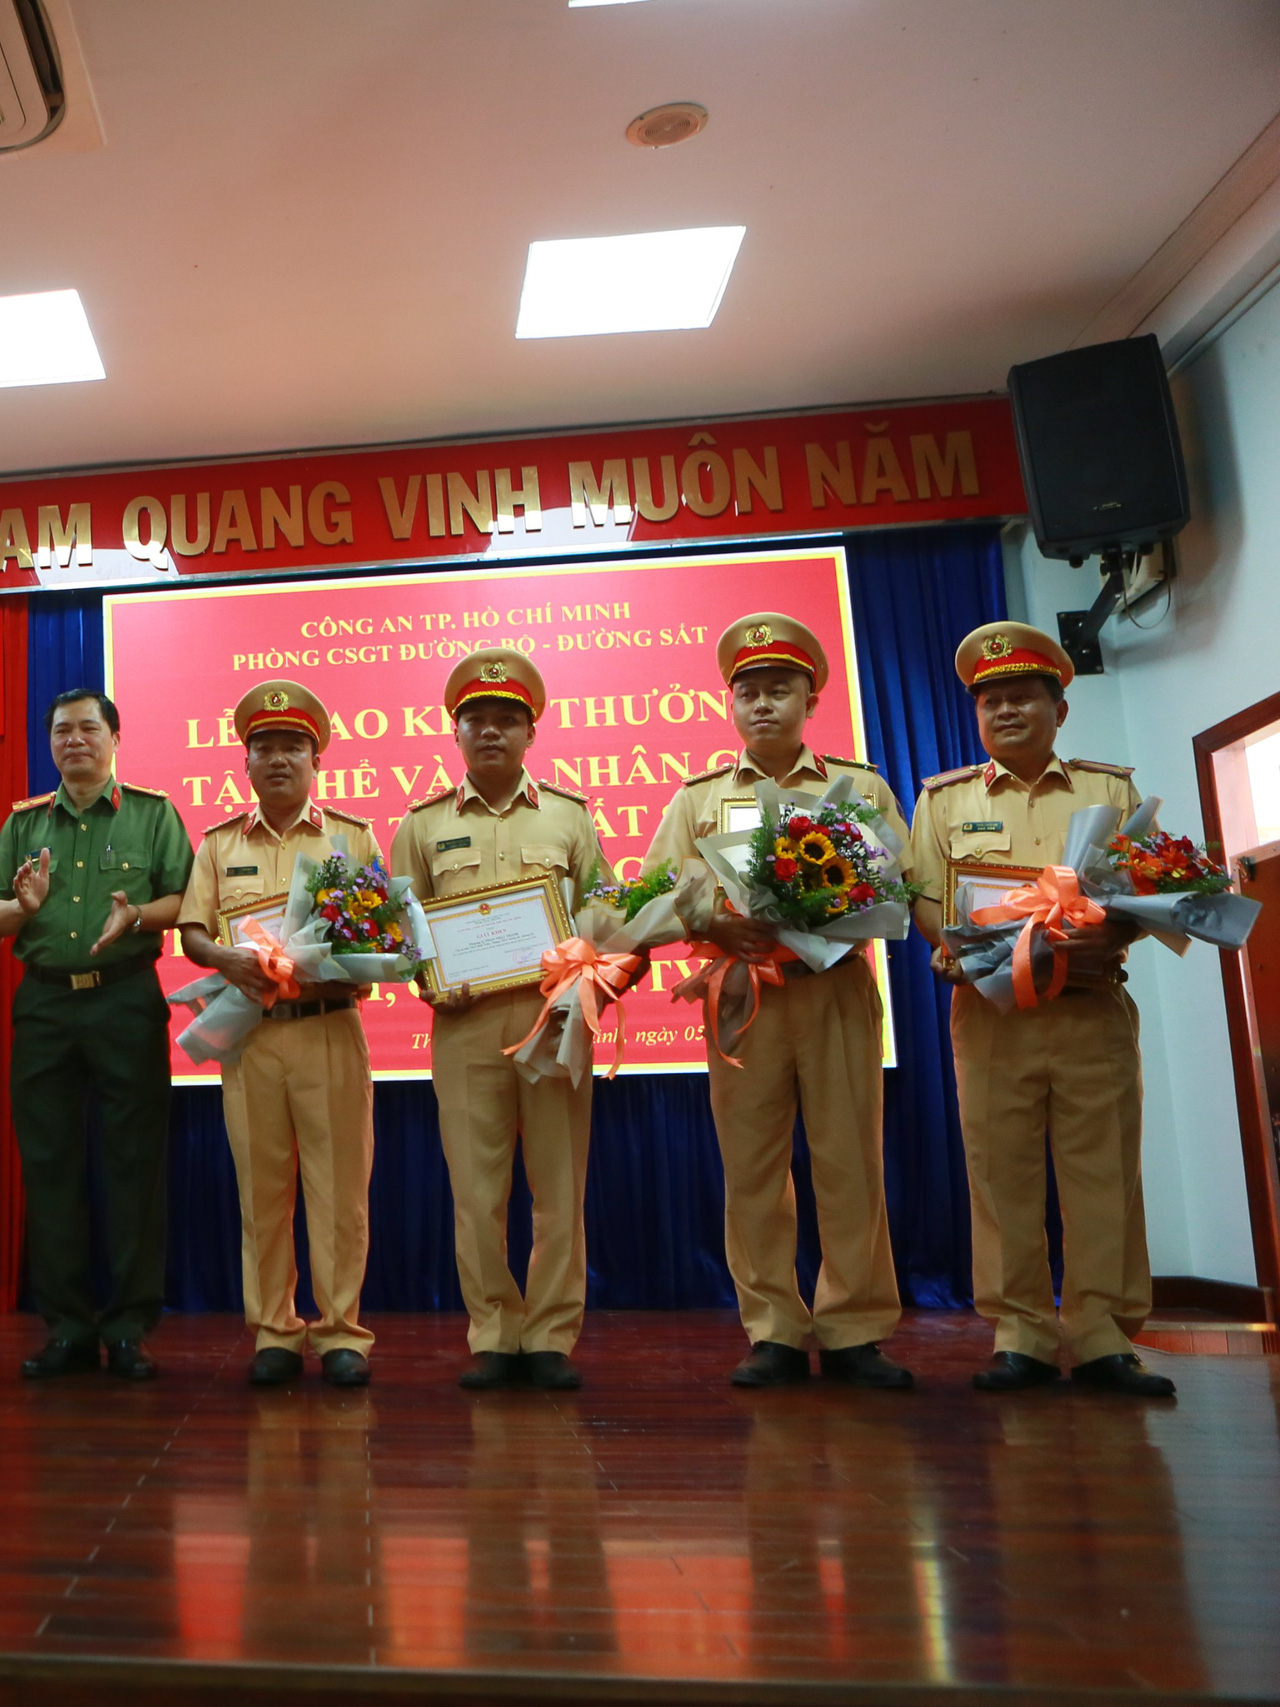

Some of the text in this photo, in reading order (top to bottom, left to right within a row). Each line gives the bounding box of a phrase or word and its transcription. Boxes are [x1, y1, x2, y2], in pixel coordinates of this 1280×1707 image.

[122, 481, 355, 570] QUANG
[378, 466, 542, 540] VINH
[568, 432, 783, 528] MUÔN
[805, 421, 980, 508] NĂM
[301, 602, 631, 639] CÔNG AN TP. HỒ CHÍ MINH
[232, 648, 320, 671] PHÒNG
[326, 645, 393, 666] CSGT
[399, 636, 492, 661] ĐƯỜNG
[557, 627, 652, 651] ĐƯỜNG
[659, 624, 708, 646] SẮT
[549, 683, 728, 729] THƯỞN
[315, 759, 380, 801] HỂ
[390, 755, 455, 797] VÀ
[552, 744, 692, 788] NHÂN
[635, 1026, 678, 1046] ngày
